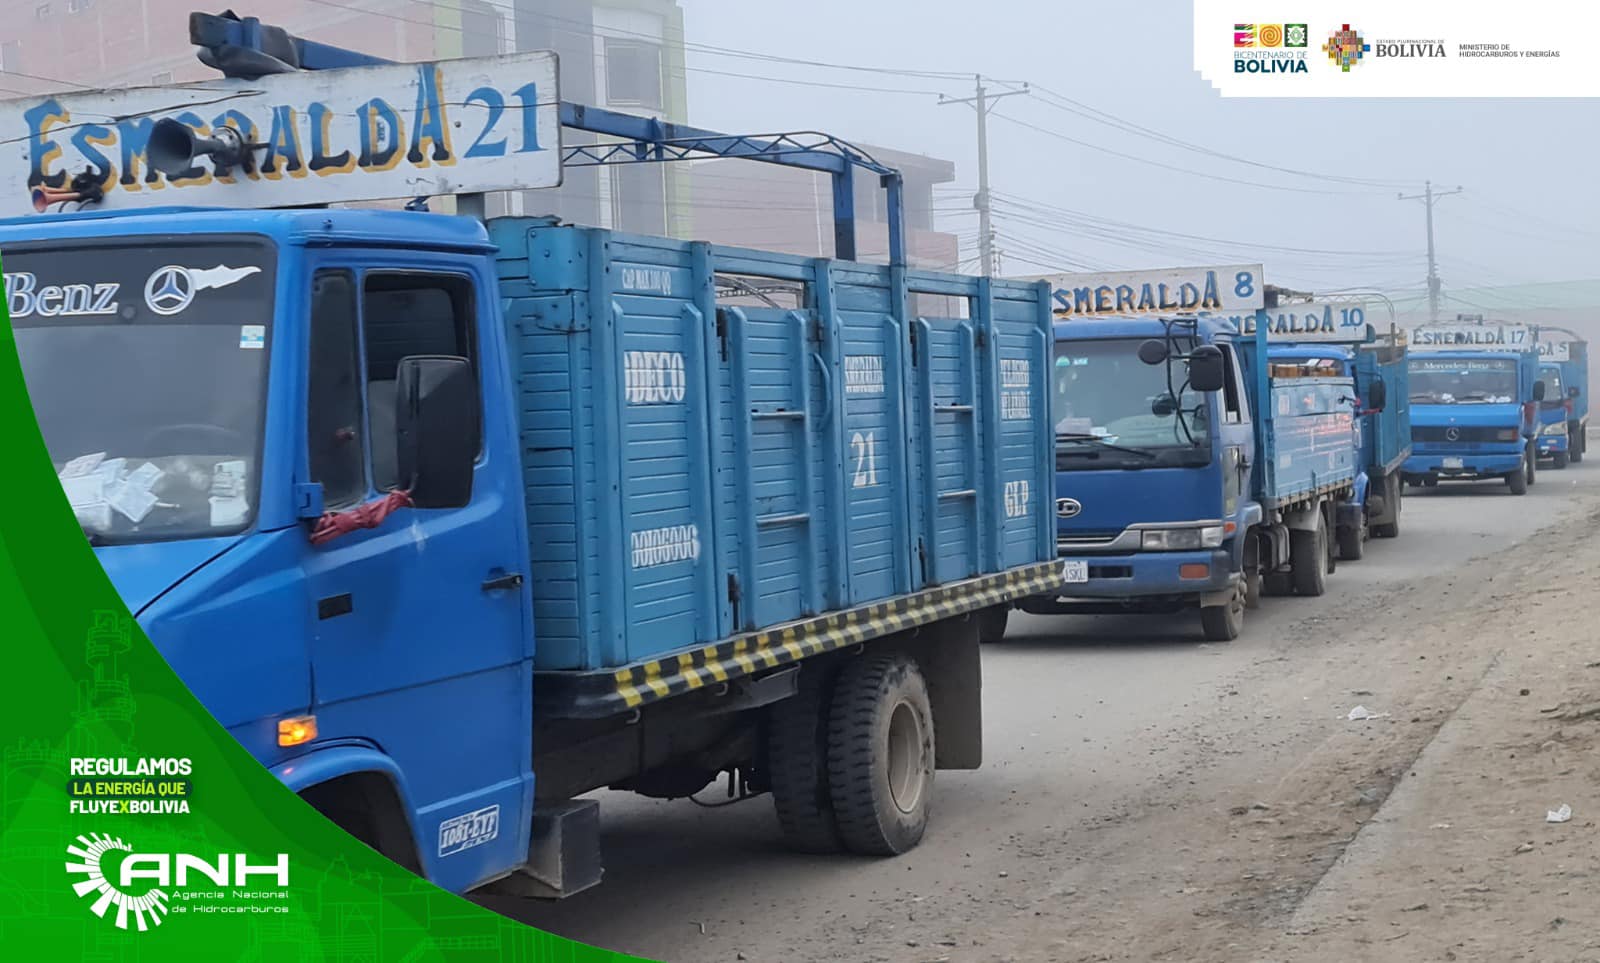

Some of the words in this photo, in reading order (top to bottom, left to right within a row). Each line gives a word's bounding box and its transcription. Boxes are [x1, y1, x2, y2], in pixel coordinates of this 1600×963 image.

[464, 82, 549, 158] 21
[3, 271, 121, 318] Benz
[1053, 270, 1223, 317] SMERALDA
[1235, 272, 1254, 298] 8
[1340, 308, 1365, 327] 10
[1412, 325, 1505, 345] ESMERALDA
[1511, 330, 1526, 344] 17
[851, 431, 877, 487] 21
[1004, 480, 1029, 517] GLP
